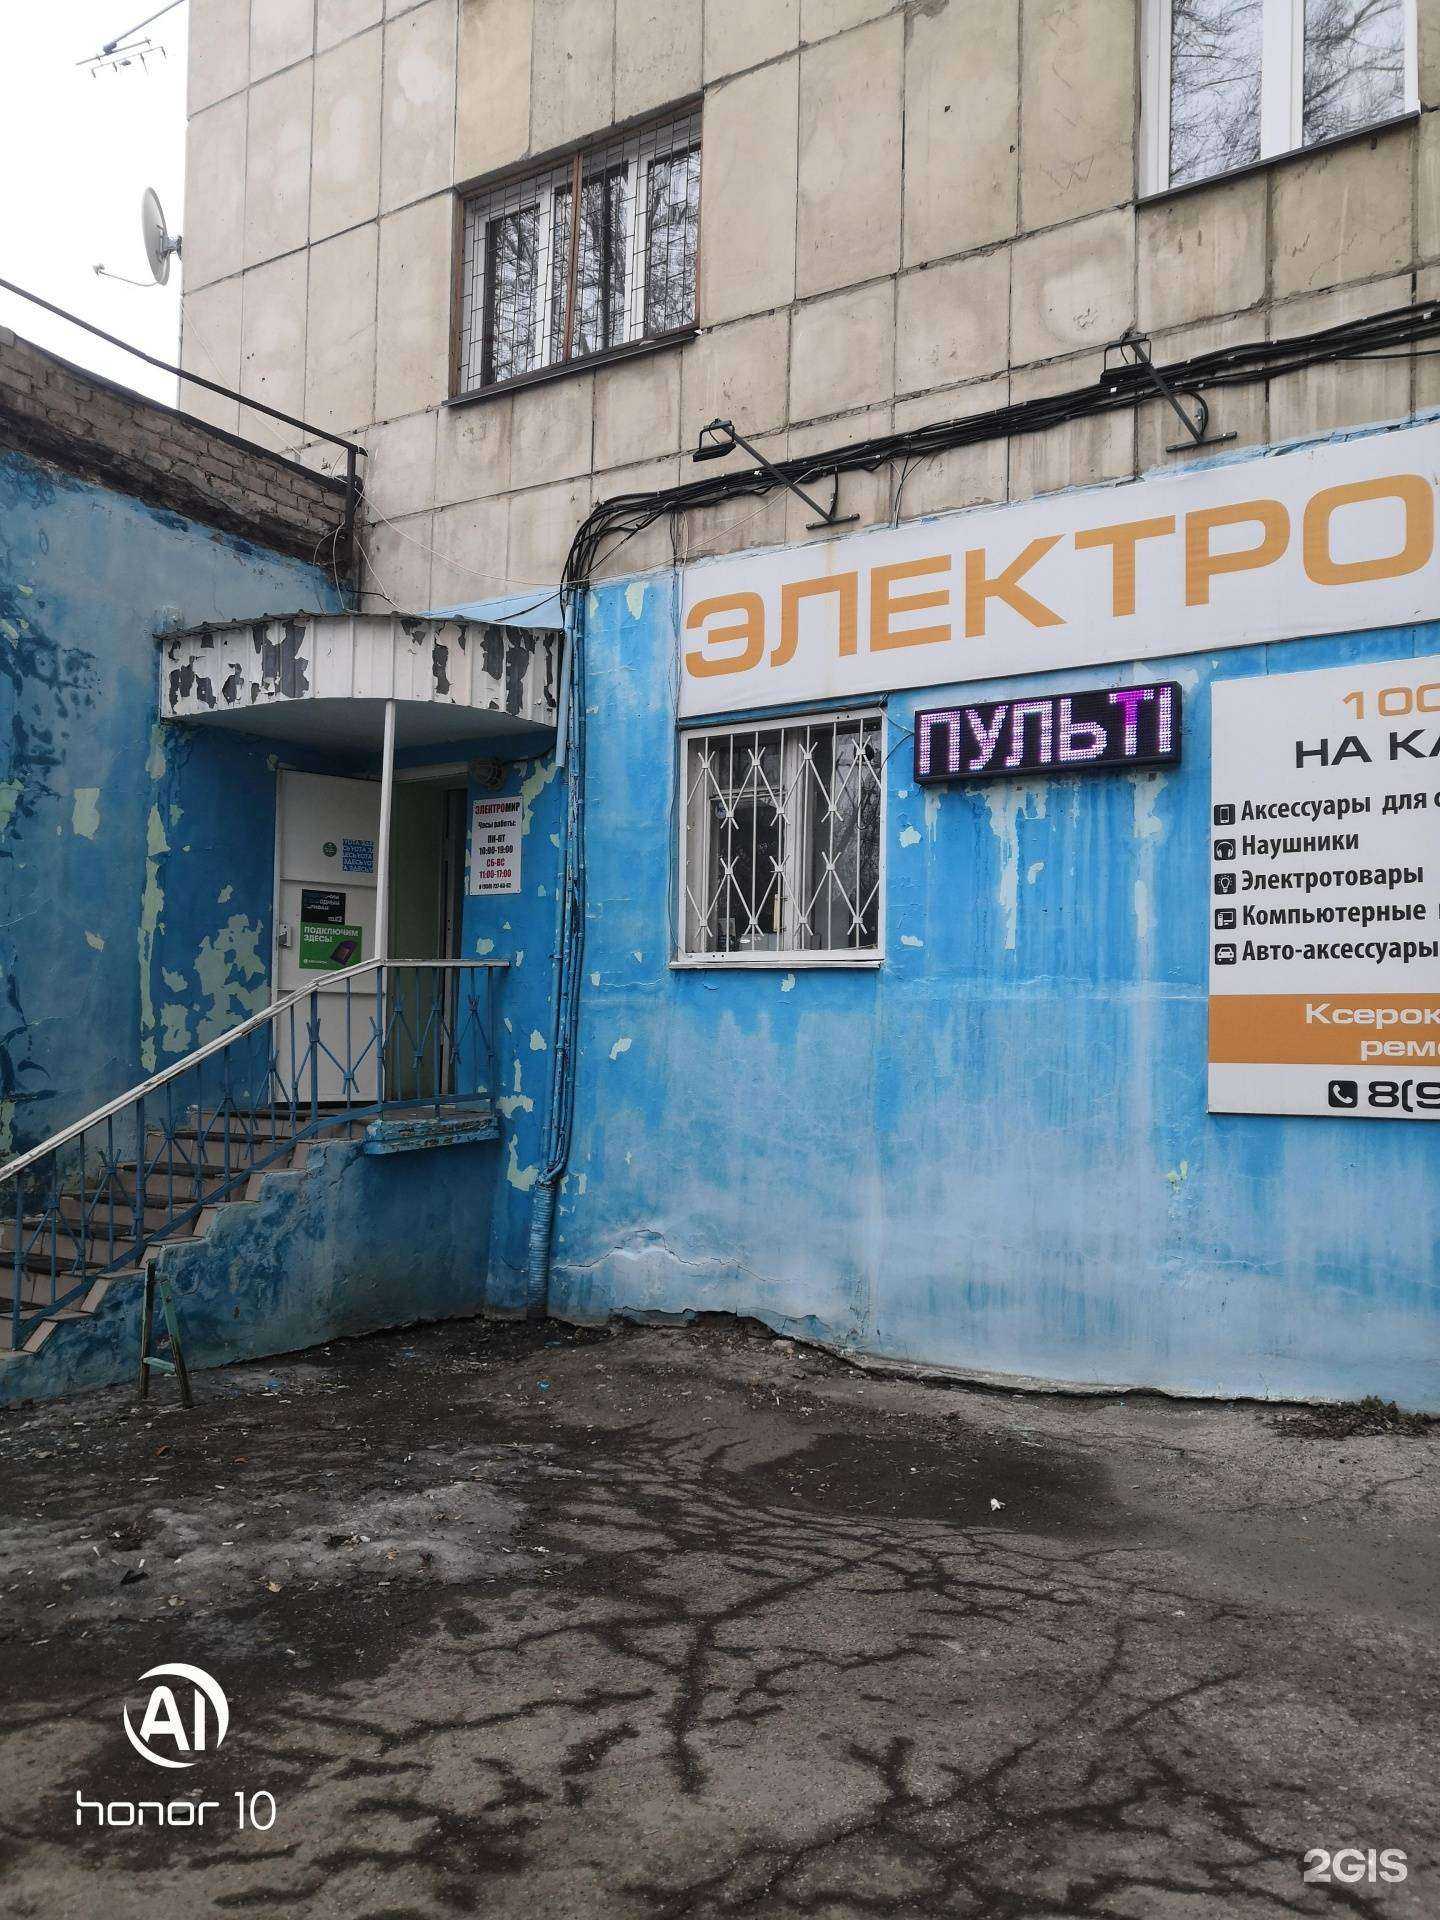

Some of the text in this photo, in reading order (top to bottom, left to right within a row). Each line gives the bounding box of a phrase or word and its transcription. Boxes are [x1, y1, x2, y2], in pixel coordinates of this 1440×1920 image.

[685, 473, 1435, 679] ЭЛЕКТРО
[1295, 729, 1440, 768] НА К
[1241, 797, 1371, 822] Аксессуары
[1382, 792, 1427, 815] для
[1242, 834, 1359, 860] Наушники
[1241, 867, 1424, 893] Электротовары
[1243, 903, 1426, 927] Компьютерные
[304, 926, 359, 937] ПОДКЛЮЧИМ
[1242, 940, 1439, 964] Авто-аксессуары
[1360, 1040, 1440, 1061] рем
